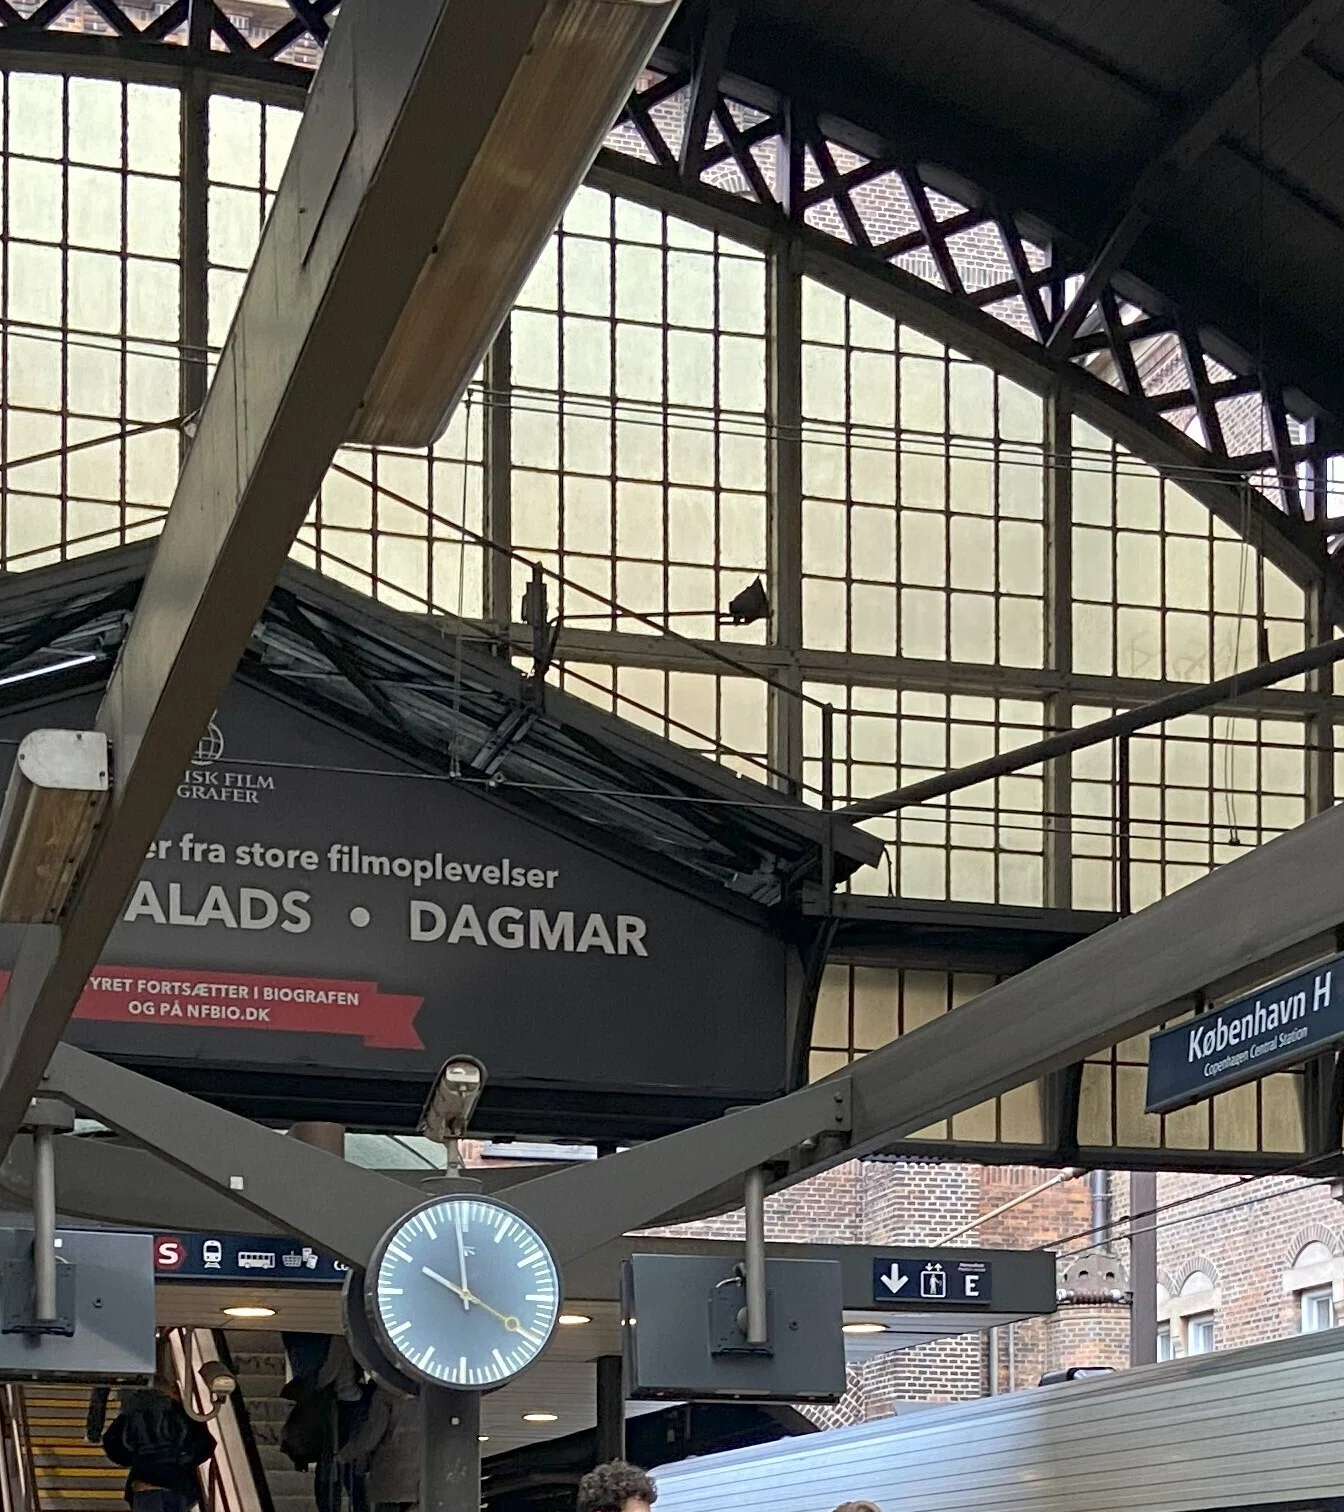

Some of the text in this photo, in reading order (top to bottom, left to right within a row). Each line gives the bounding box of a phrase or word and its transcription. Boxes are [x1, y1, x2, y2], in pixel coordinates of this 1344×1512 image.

[184, 770, 275, 790] ISK FILM
[176, 785, 260, 804] GRAFER
[179, 833, 226, 864] fra
[235, 842, 319, 871] store
[328, 844, 560, 889] filmoplevelser
[123, 880, 312, 934] ALADS
[409, 900, 648, 957] DAGMAR
[137, 979, 249, 1000] FORTSÆTTER
[253, 987, 259, 1000] I
[263, 987, 360, 1006] BIOGRAFEN
[128, 999, 271, 1023] OG PÅ NFBIO.DK
[1188, 971, 1332, 1063] København H
[1203, 1026, 1309, 1077] Copenhagen Central Station
[158, 1242, 179, 1265] S
[965, 1275, 980, 1296] E
